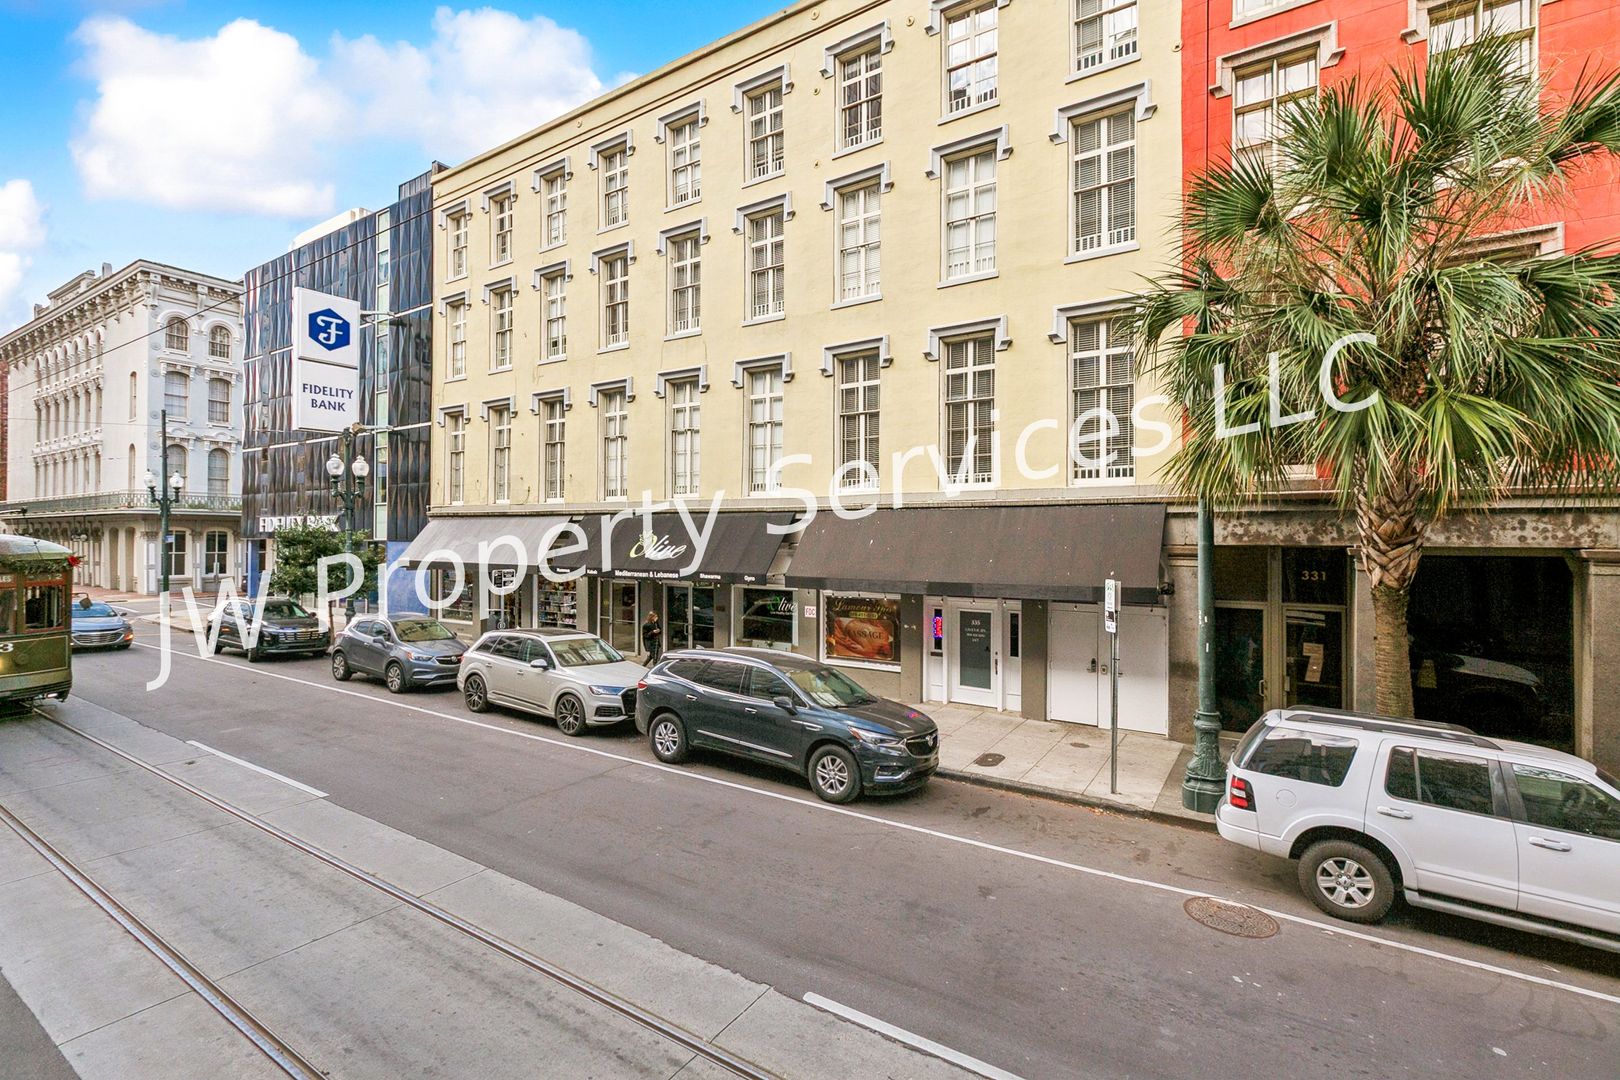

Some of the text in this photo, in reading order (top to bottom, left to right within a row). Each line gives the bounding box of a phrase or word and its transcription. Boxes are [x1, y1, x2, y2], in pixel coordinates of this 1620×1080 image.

[302, 383, 353, 399] FIDELITY
[311, 399, 346, 412] BANK
[630, 532, 687, 560] Olive
[615, 570, 648, 578] Mediterranean
[654, 571, 679, 579] Lebanese
[1301, 570, 1327, 580] 331
[805, 607, 816, 616] FDC
